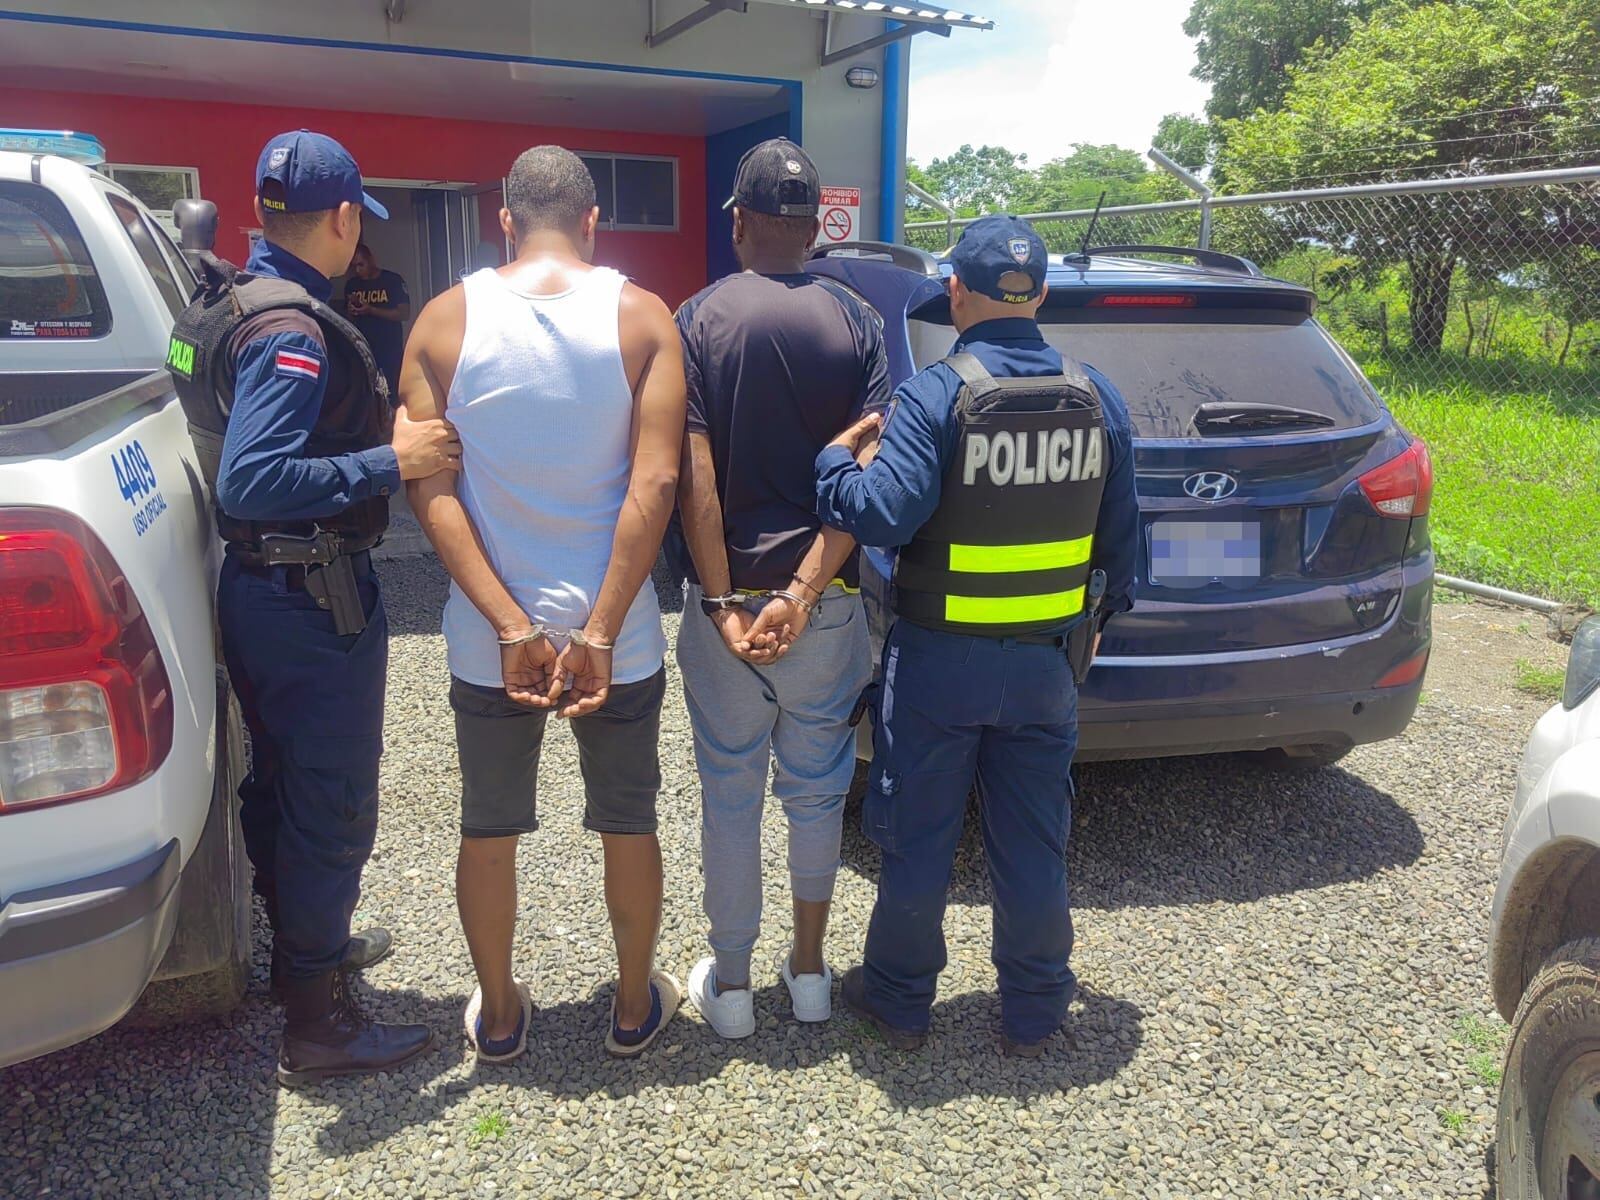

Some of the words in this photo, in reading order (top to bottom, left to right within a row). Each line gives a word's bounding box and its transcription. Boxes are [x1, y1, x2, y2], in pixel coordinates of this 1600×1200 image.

[821, 189, 858, 197] ROHIBIDO
[263, 197, 286, 210] POLICIA
[824, 197, 851, 205] FUMAR
[1003, 292, 1029, 303] POLICIA
[963, 427, 1102, 487] POLICIA
[111, 440, 156, 506] 4409
[132, 510, 148, 536] USO
[144, 492, 167, 524] OFICIAL
